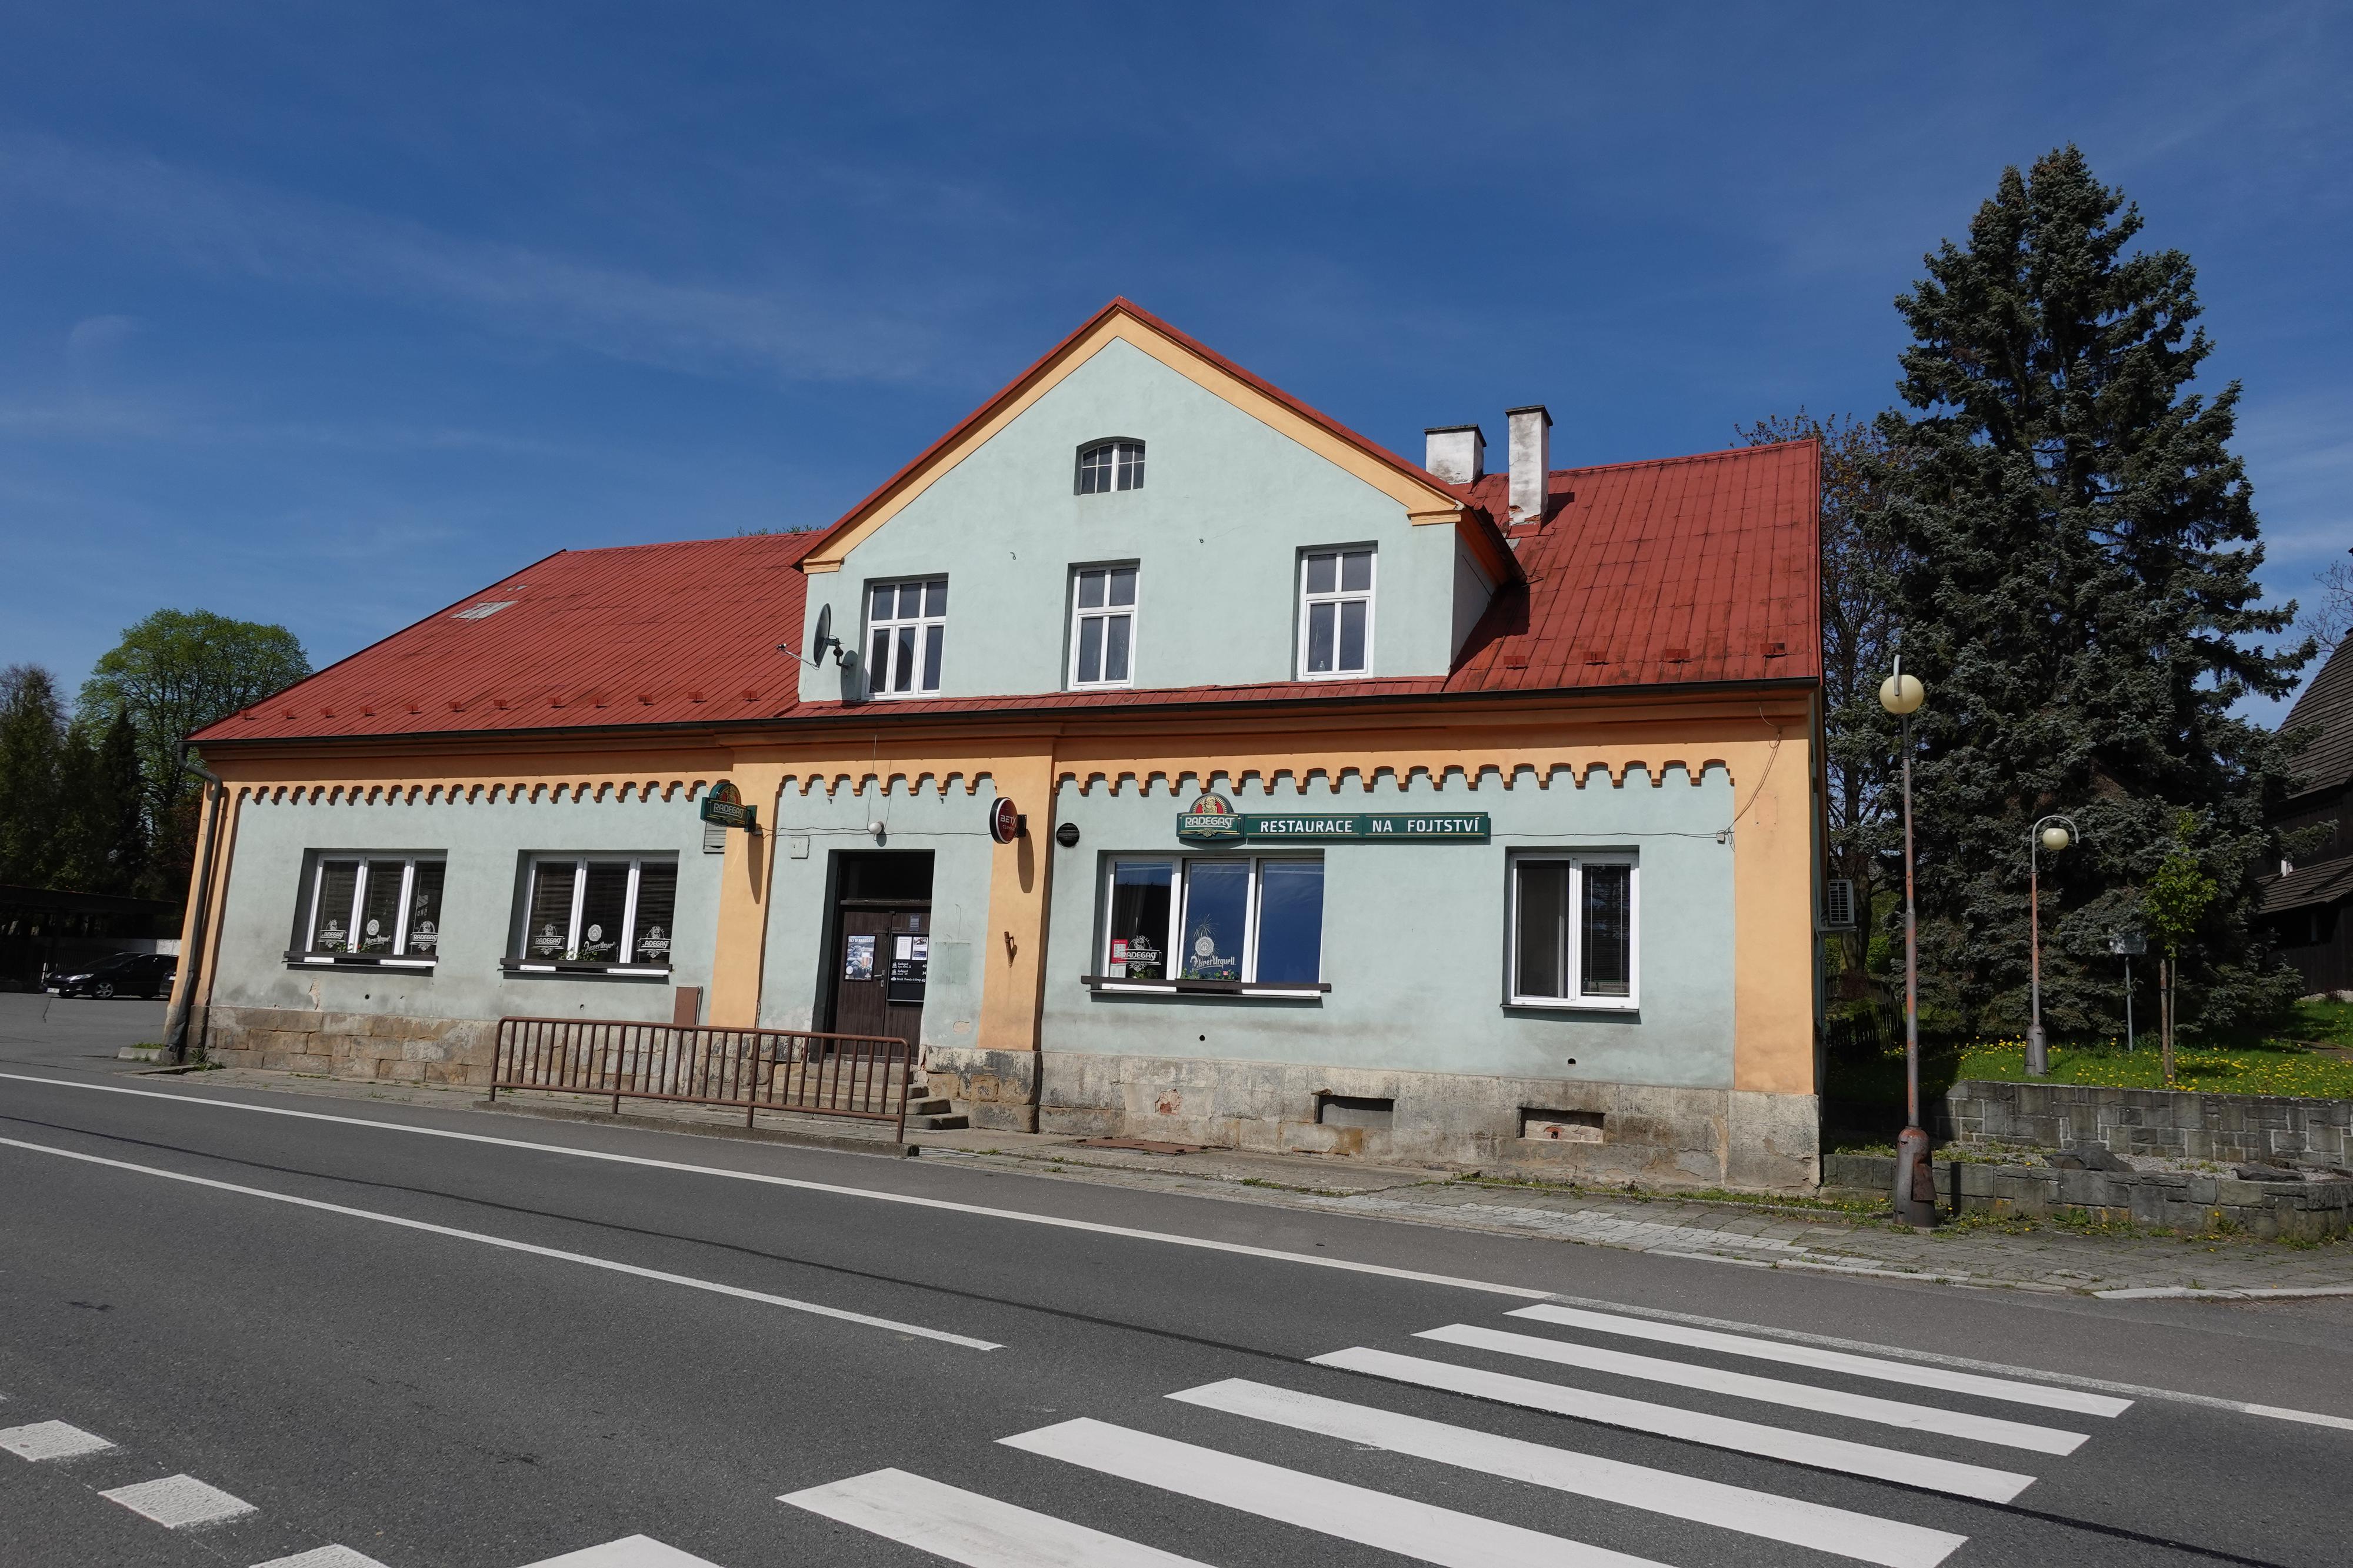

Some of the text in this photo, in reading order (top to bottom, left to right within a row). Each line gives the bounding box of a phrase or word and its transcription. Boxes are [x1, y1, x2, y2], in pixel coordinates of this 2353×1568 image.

[714, 803, 744, 819] RADEGAST
[1185, 816, 1235, 829] RADEGAST
[1260, 817, 1480, 833] RESTAURACE NA FOJTSTVÍ
[535, 938, 562, 946] RADEGAST
[1212, 955, 1235, 969] Urquell
